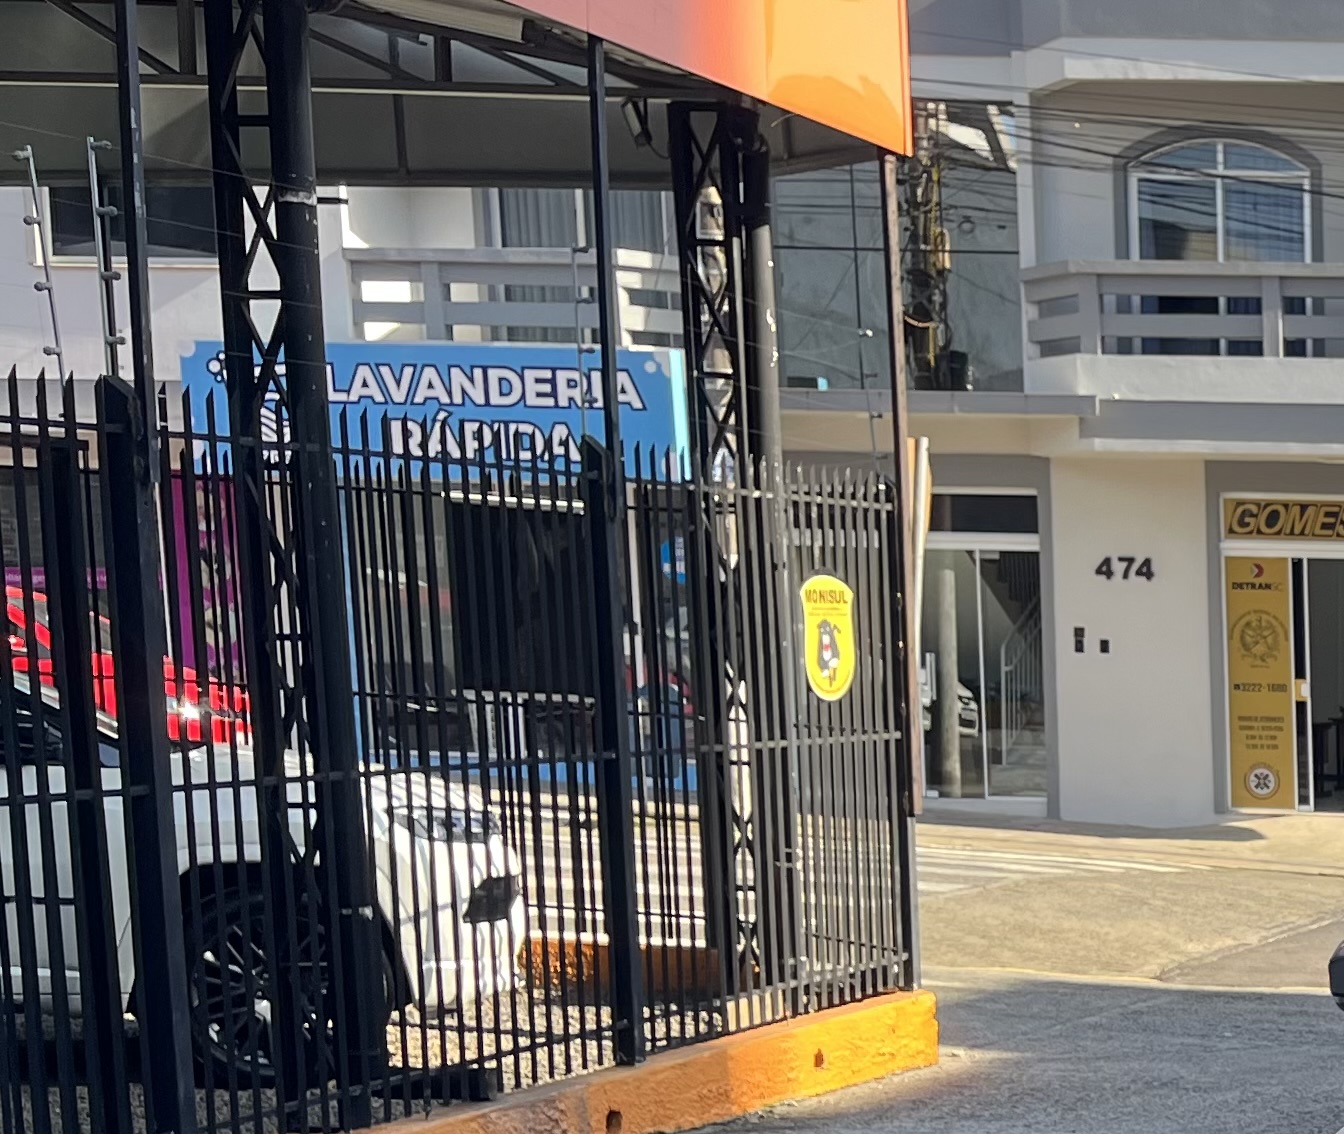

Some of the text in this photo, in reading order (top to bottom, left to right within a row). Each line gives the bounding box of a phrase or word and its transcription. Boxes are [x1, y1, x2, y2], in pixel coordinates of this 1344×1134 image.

[326, 362, 647, 411] LAVANDERIA
[388, 408, 584, 462] RÁPIDA
[1095, 556, 1155, 582] 474
[804, 588, 849, 604] MONISUL
